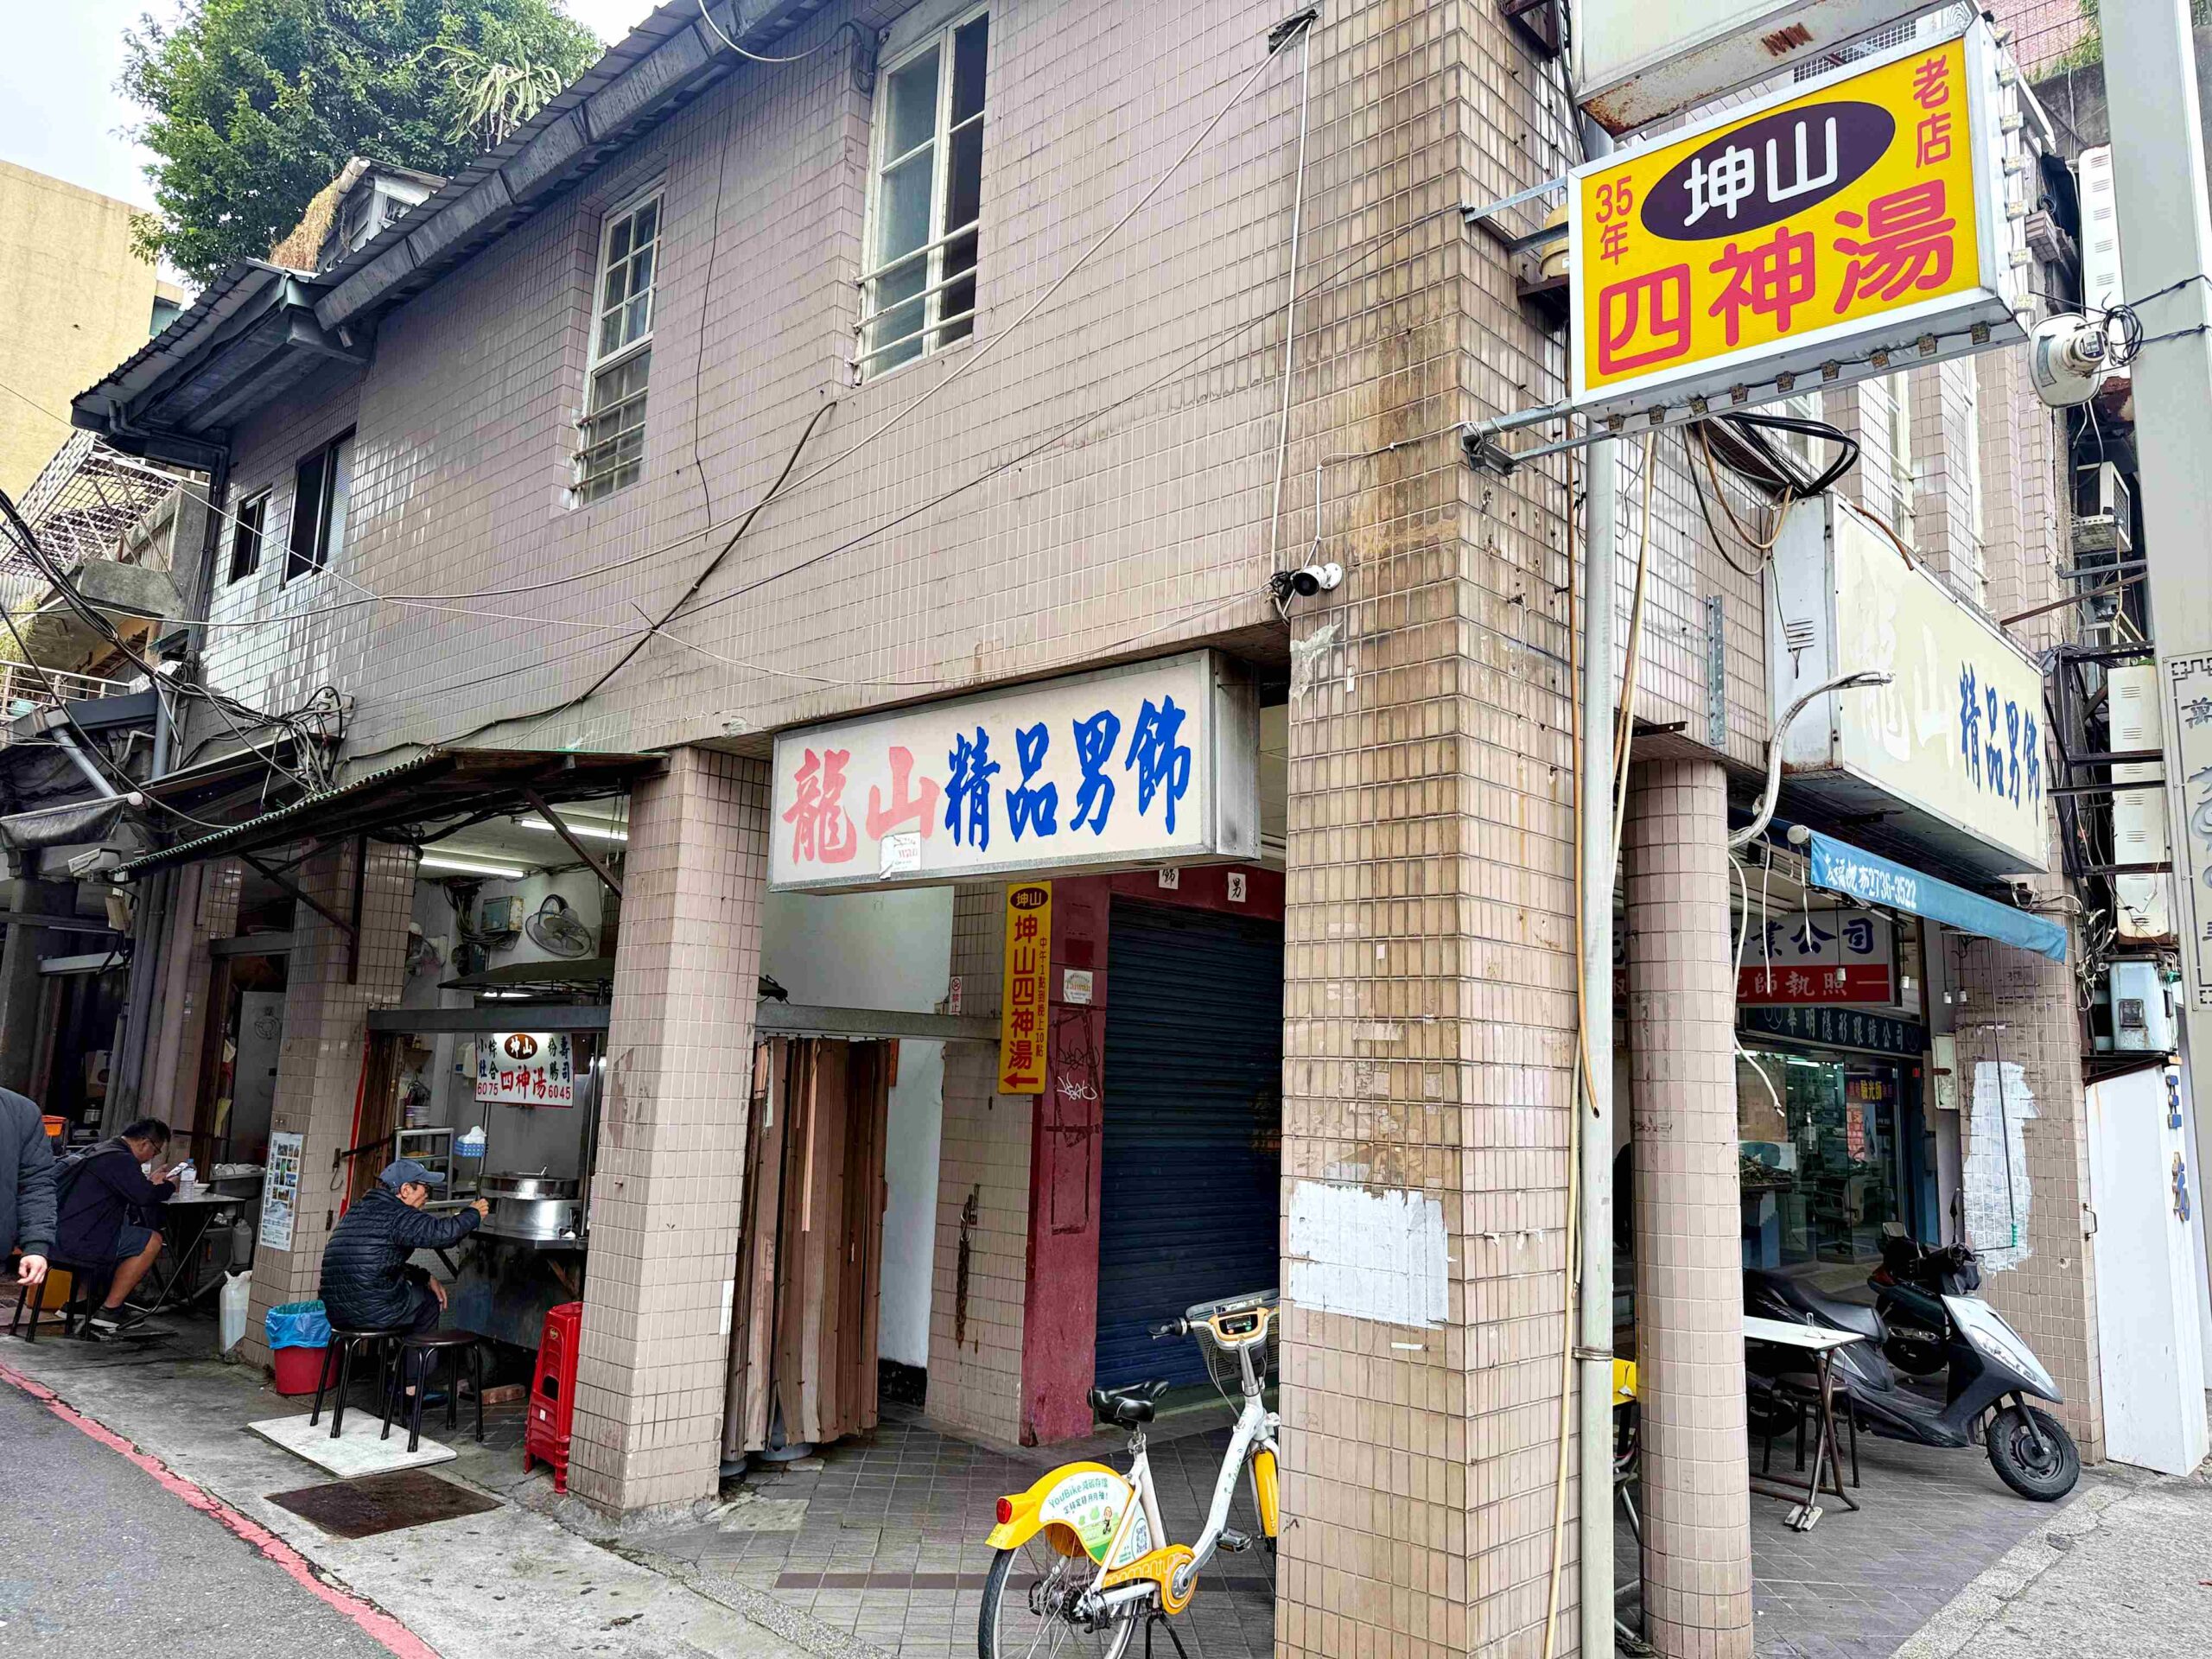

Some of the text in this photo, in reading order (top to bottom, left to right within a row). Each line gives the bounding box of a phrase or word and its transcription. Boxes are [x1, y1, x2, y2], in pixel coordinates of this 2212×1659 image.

[1912, 54, 1952, 169] 老店
[1682, 116, 1839, 227] 坤山
[1595, 175, 1633, 266] 35年
[1597, 178, 1957, 377] 四神湯
[782, 694, 1192, 866] 龍山精品男飾
[1016, 892, 1042, 906] 坤山
[1231, 877, 1242, 899] 男
[1008, 914, 1038, 1070] 坤山四神湯
[500, 1065, 547, 1099] 四神湯
[510, 1036, 532, 1058] 坤山
[559, 1035, 570, 1083] 壽司
